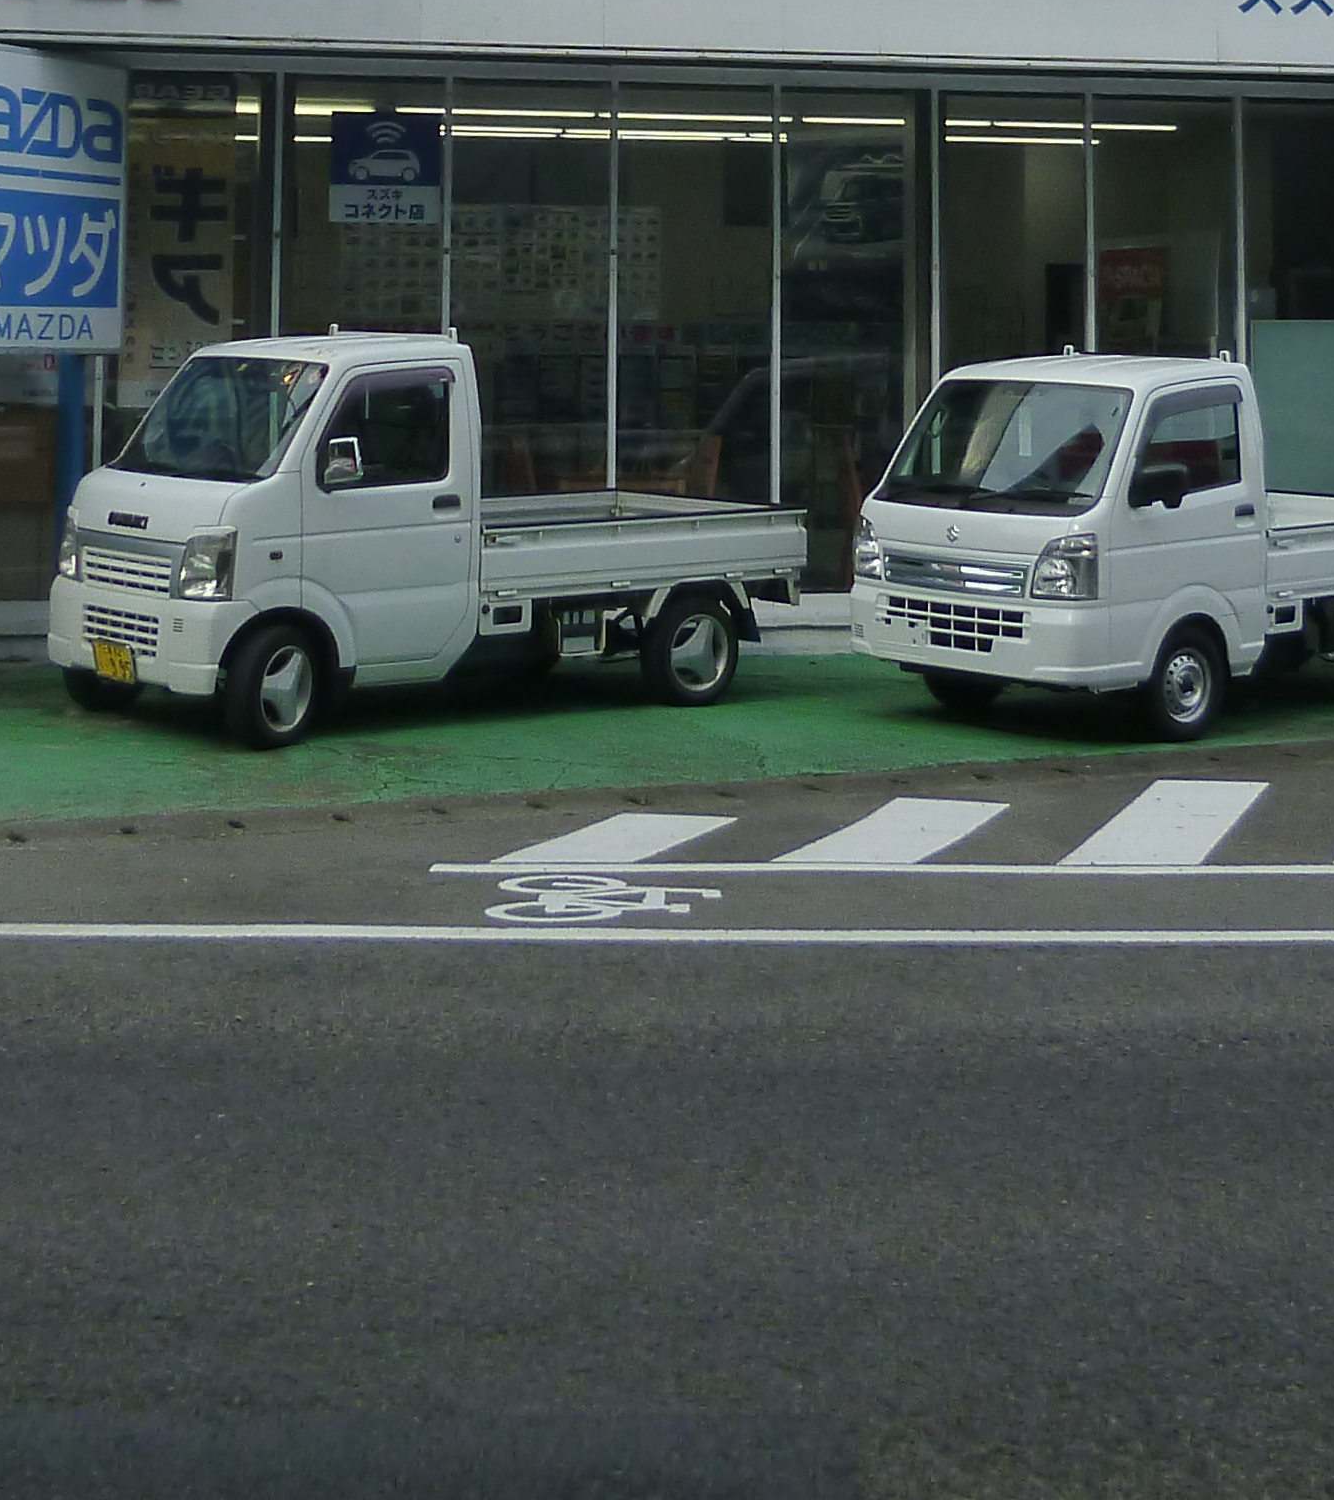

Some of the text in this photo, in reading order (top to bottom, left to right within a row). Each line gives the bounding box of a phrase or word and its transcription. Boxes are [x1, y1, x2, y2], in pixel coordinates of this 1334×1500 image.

[367, 188, 403, 201] スズキ
[344, 203, 426, 220] コネクト店
